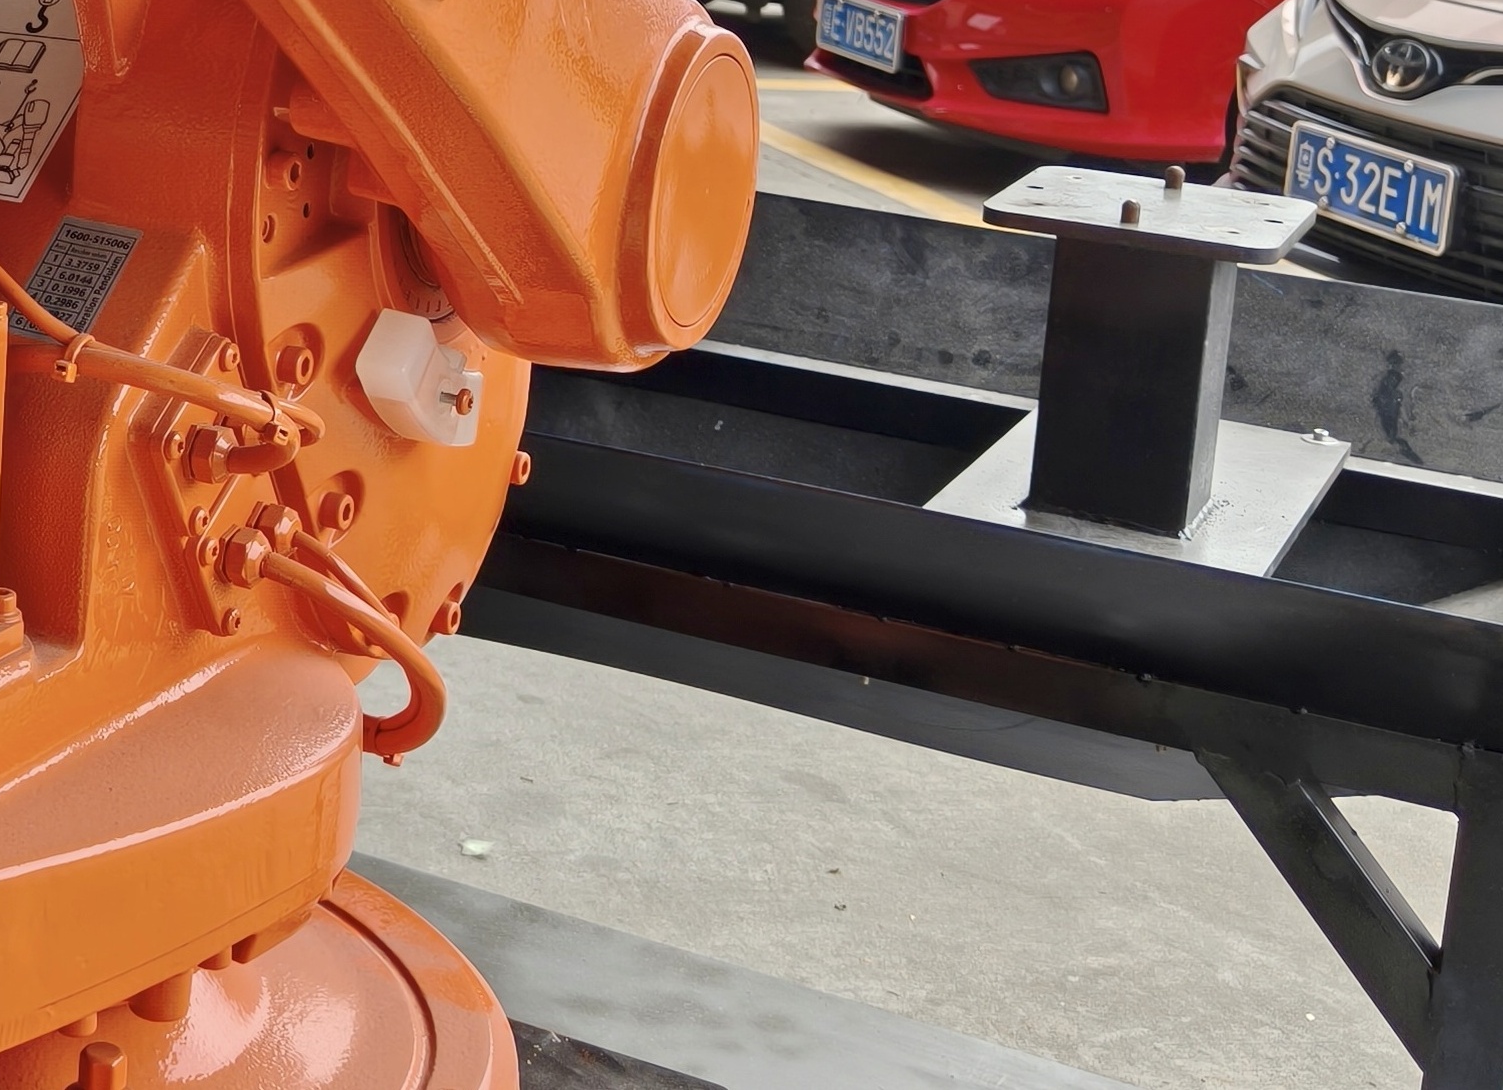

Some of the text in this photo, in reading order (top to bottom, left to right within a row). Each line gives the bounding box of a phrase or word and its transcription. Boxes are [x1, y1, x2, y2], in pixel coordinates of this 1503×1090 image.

[64, 229, 132, 250] 1600-515006
[52, 254, 101, 271] 1 3.3759
[44, 266, 94, 285] 2 6.0144
[96, 255, 123, 296] Pendulum
[37, 279, 88, 297] 3 0.1996
[44, 294, 80, 309] 0.2986
[15, 317, 23, 326] 6
